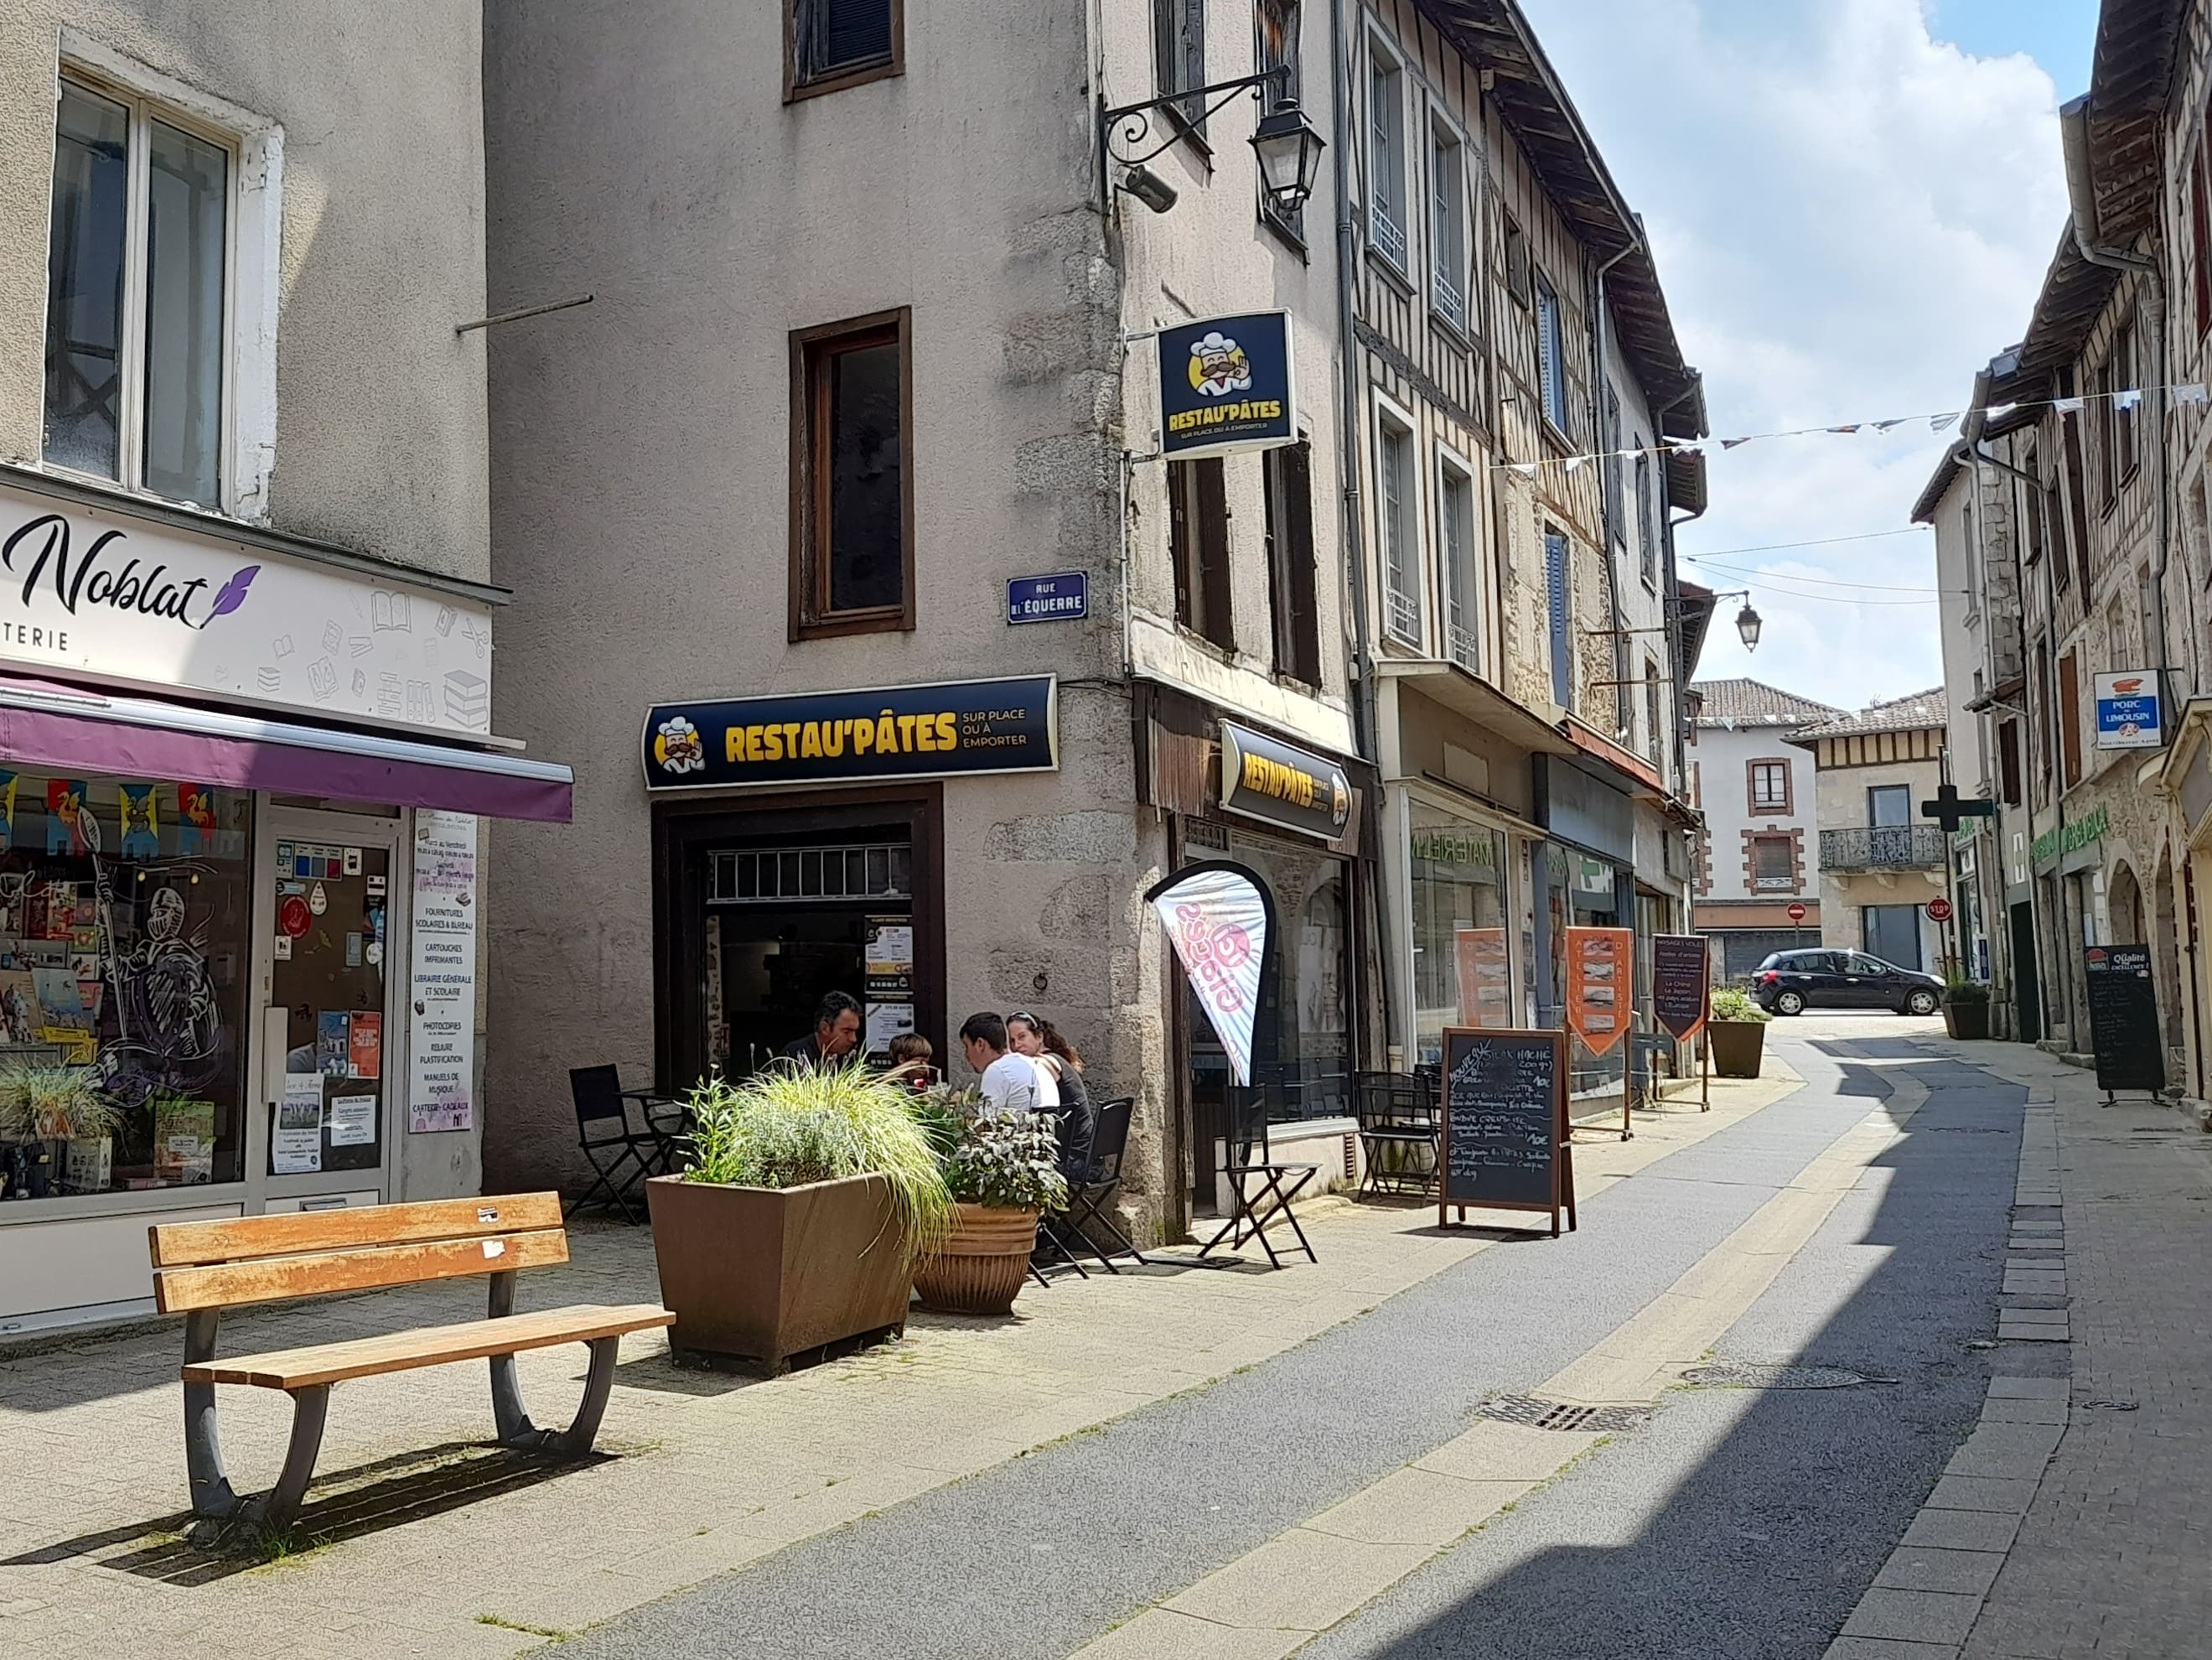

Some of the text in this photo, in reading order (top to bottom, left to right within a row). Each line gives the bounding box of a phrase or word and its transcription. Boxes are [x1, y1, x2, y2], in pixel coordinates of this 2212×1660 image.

[1168, 399, 1281, 432] RESTAU'PÂTES
[1231, 423, 1268, 431] EMPORTER
[2, 514, 209, 630] Noblat
[1036, 583, 1056, 594] RUE
[2112, 700, 2141, 709] PORC
[2106, 712, 2150, 723] LIMOUSIN
[962, 722, 992, 735] OU À
[725, 708, 1026, 763] RESTAU'PÂTES SUR PLACE
[962, 734, 1027, 749] EMPORTER
[1242, 751, 1314, 808] RESTAU'PÂTES
[1930, 904, 1950, 915] STOP
[425, 943, 463, 952] CARTOUCHES
[2113, 953, 2146, 964] Qualité
